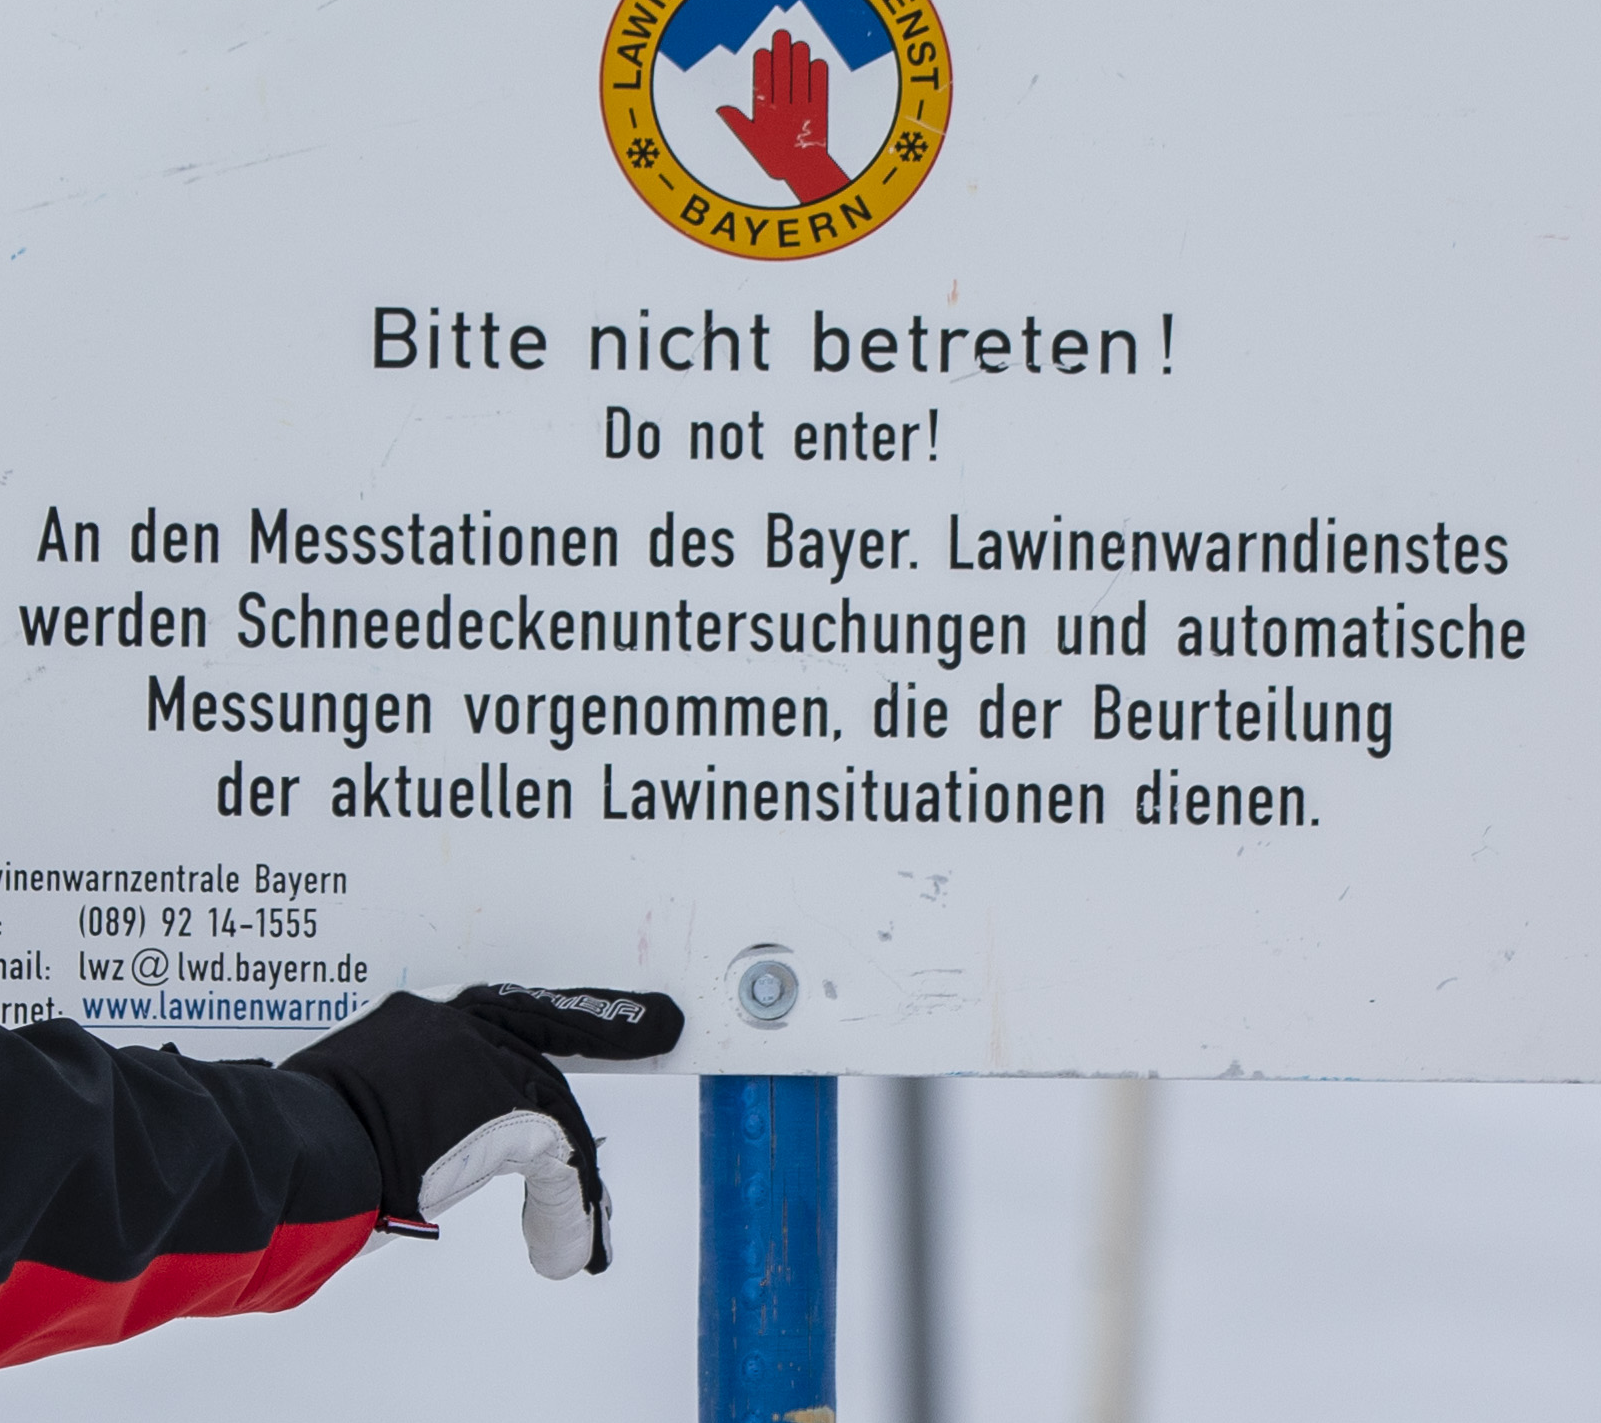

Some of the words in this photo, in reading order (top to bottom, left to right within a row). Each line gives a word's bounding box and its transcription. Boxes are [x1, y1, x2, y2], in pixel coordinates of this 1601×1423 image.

[679, 193, 874, 249] BAYERN
[373, 305, 548, 371] Bitte
[589, 307, 771, 372] nicht
[605, 405, 661, 461] Do
[689, 410, 765, 461] not
[793, 407, 939, 463] enter!
[36, 505, 100, 564] An
[130, 505, 220, 565] den
[249, 506, 619, 568] Messstationen
[648, 510, 736, 569] des
[766, 511, 919, 586] Bayer.
[949, 512, 1509, 576] Lawinenwarndienstes
[18, 589, 207, 649] werden
[237, 590, 1027, 672] Schneedeckenuntersuchungen
[1056, 598, 1147, 657] und
[1177, 601, 1526, 661] automatische
[147, 674, 432, 751] Messungen
[463, 693, 843, 752] vorgenommen,
[873, 680, 949, 740] die
[979, 681, 1063, 741] der
[1093, 682, 1393, 760] Beurteilung
[216, 759, 301, 818] der
[331, 760, 573, 820] aktuellen
[602, 762, 1105, 825] Lawinensituationen
[1135, 767, 1321, 828] dienen.
[255, 863, 348, 902] Bayern
[78, 905, 146, 938] (089)
[162, 906, 193, 937] 92
[208, 907, 318, 938] 14-1555
[82, 990, 370, 1022] www.lawinenwarndi
